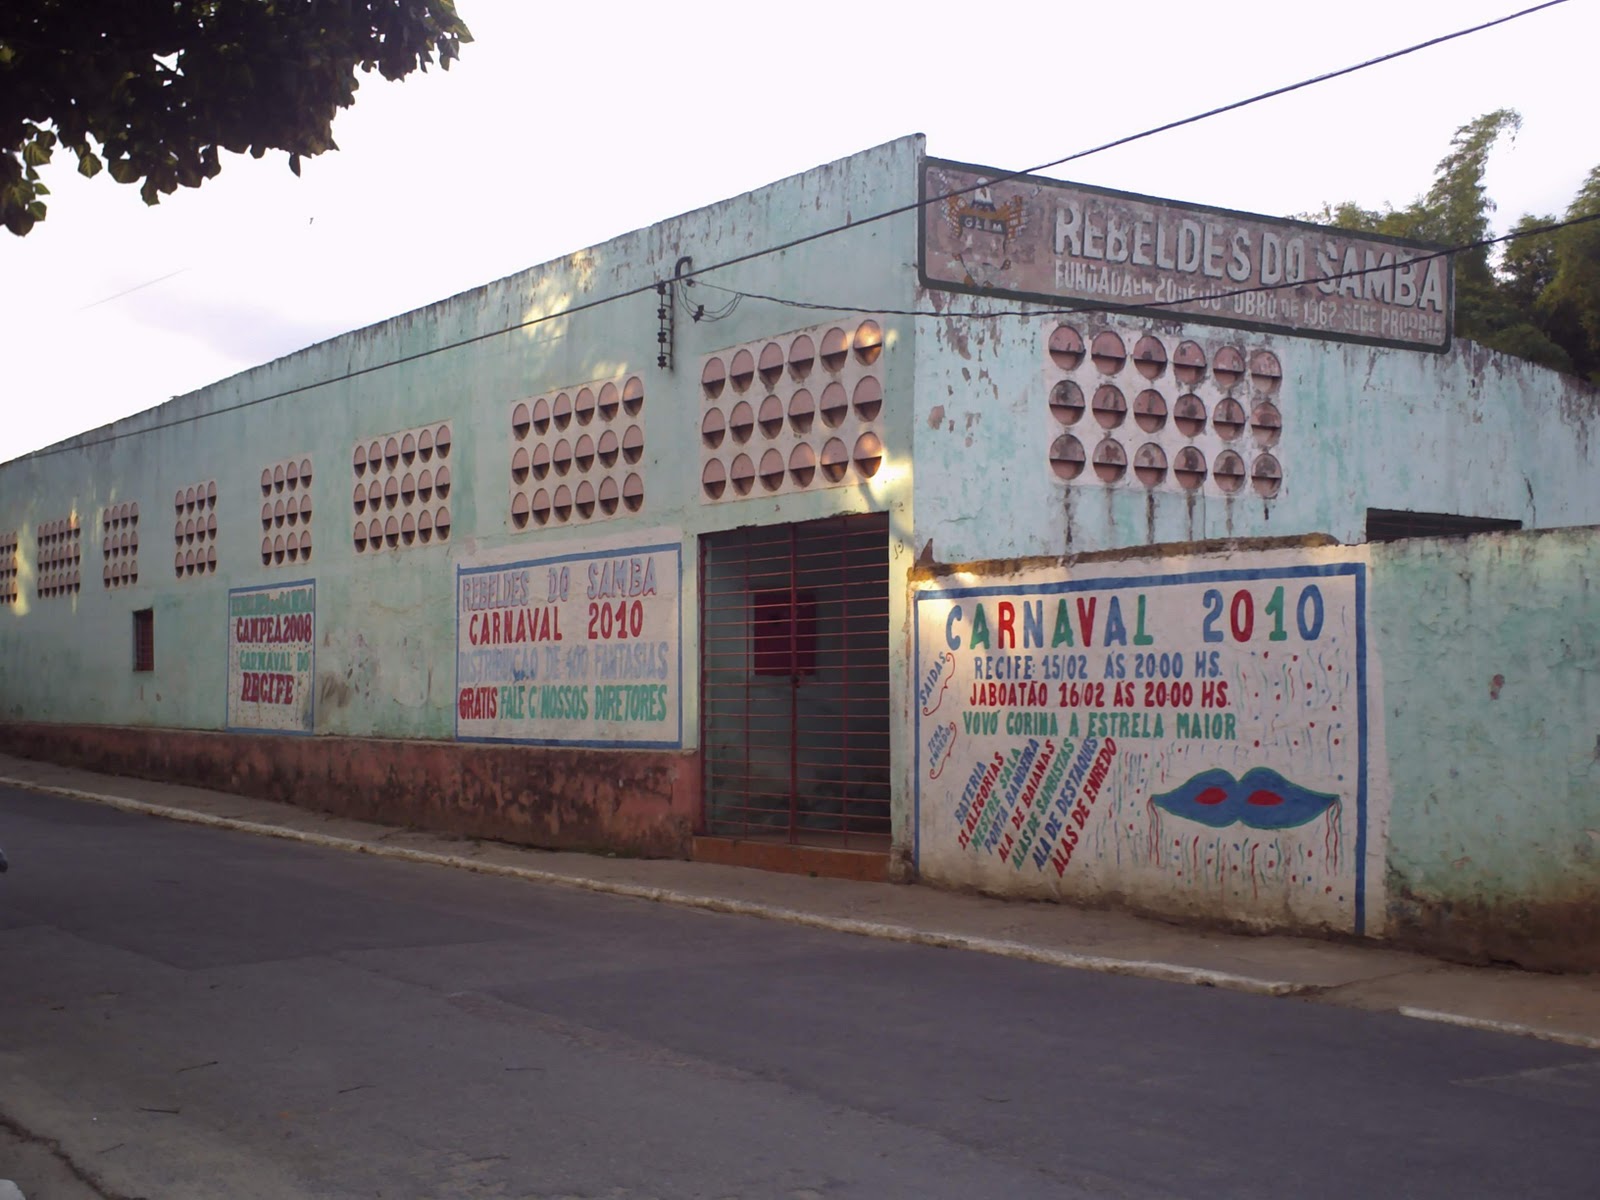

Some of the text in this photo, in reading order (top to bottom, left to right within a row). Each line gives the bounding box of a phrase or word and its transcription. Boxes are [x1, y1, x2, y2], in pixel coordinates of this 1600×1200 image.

[1053, 197, 1444, 313] REBELDES DO SAMBA
[1154, 277, 1177, 303] 20
[463, 556, 658, 612] REBELDES DO SAMBA
[283, 613, 312, 643] 2008
[469, 599, 644, 646] CARNAVAL 2010
[944, 584, 1325, 650] CARNAVAL 2010
[239, 650, 310, 672] CARNAVAL DO
[594, 641, 670, 681] FANTASIAS
[973, 655, 1036, 680] RECIFE:
[1041, 653, 1088, 682] 15/02
[1134, 652, 1184, 679] 20:00
[1194, 651, 1224, 679] HS.
[240, 672, 295, 705] RECIFE
[500, 685, 525, 720] FALE
[541, 684, 588, 721] NOSSOS
[594, 684, 668, 721] DIRETORES
[969, 680, 1049, 708] JABOATÃO
[1058, 682, 1106, 709] 16/02
[1144, 681, 1194, 708] 20:00
[1201, 680, 1232, 709] HS.
[928, 724, 944, 754] TEMA
[929, 726, 951, 768] ENREDO
[1006, 711, 1059, 738] CORINA
[1068, 711, 1080, 738] A
[1086, 711, 1166, 740] ESTRELA
[1175, 712, 1237, 740] MAIOR
[954, 761, 987, 826] BATERIA
[966, 751, 1004, 835] ALEGORIAS
[971, 747, 1022, 852] MESTRE SALA
[984, 738, 1040, 856] PORTA BANDEIRA
[998, 739, 1055, 864] ALA DE BAIANAS
[1011, 737, 1076, 872] ALAS DE SAMBISTAS
[1032, 735, 1100, 873] ALA DE DESTAQUES
[1051, 737, 1118, 879] ALAS DE ENREDO
